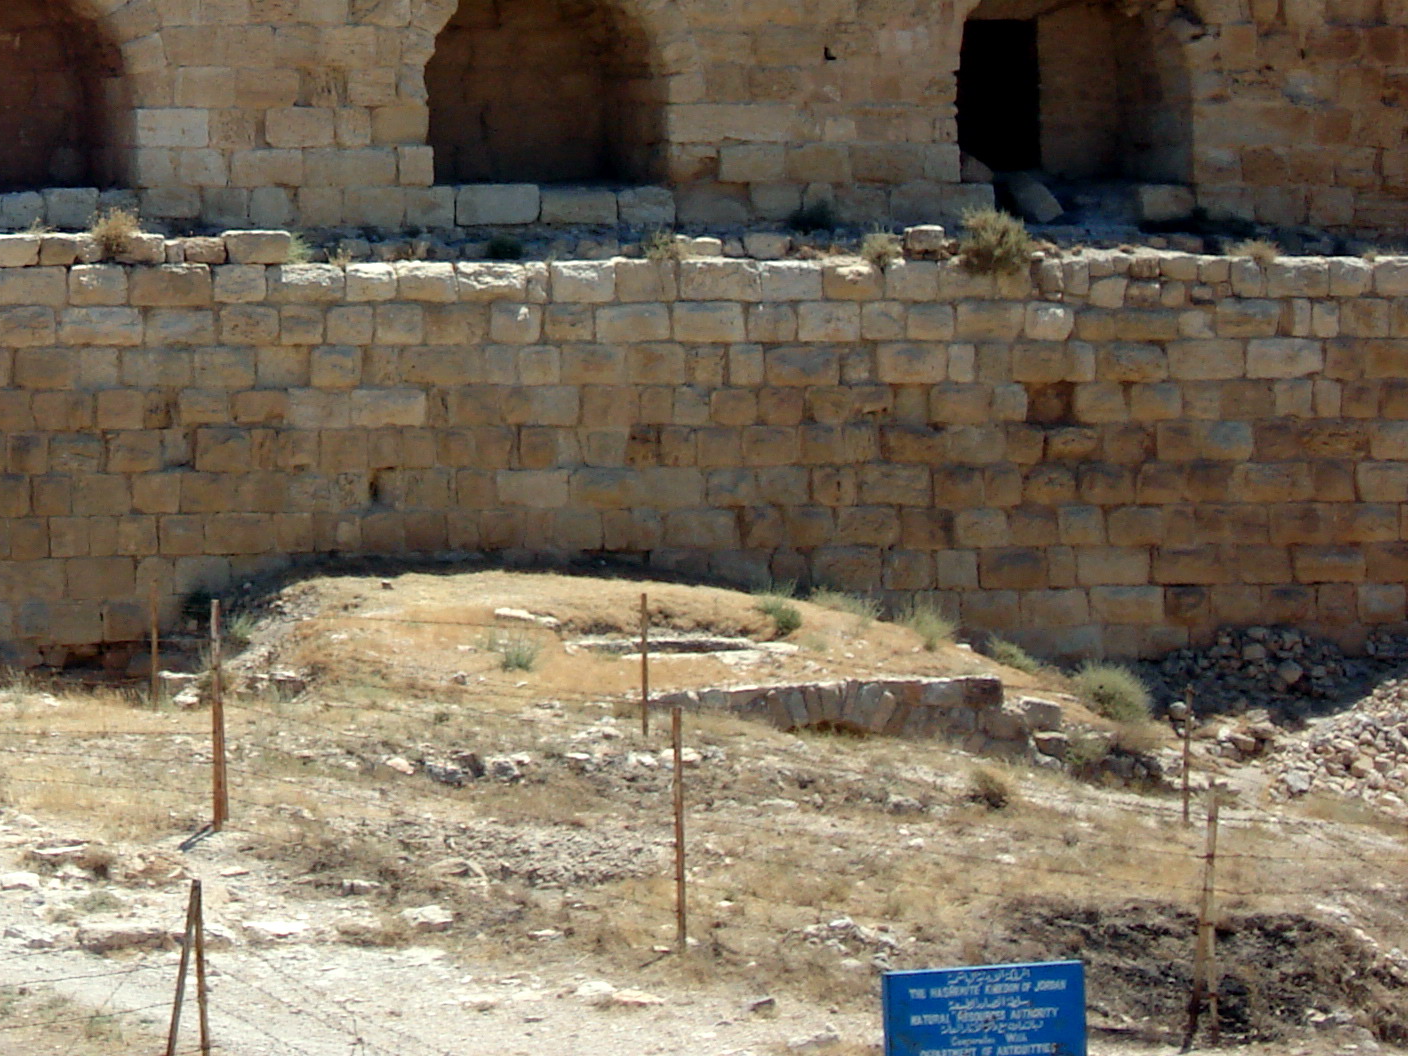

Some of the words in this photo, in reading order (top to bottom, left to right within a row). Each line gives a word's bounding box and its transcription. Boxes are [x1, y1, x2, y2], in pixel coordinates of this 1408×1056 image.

[909, 988, 927, 999] THE
[1021, 981, 1032, 992] OF
[1034, 979, 1067, 992] JORDAN
[910, 1014, 950, 1026] NATURAL
[1010, 1007, 1059, 1020] AUTHORITY
